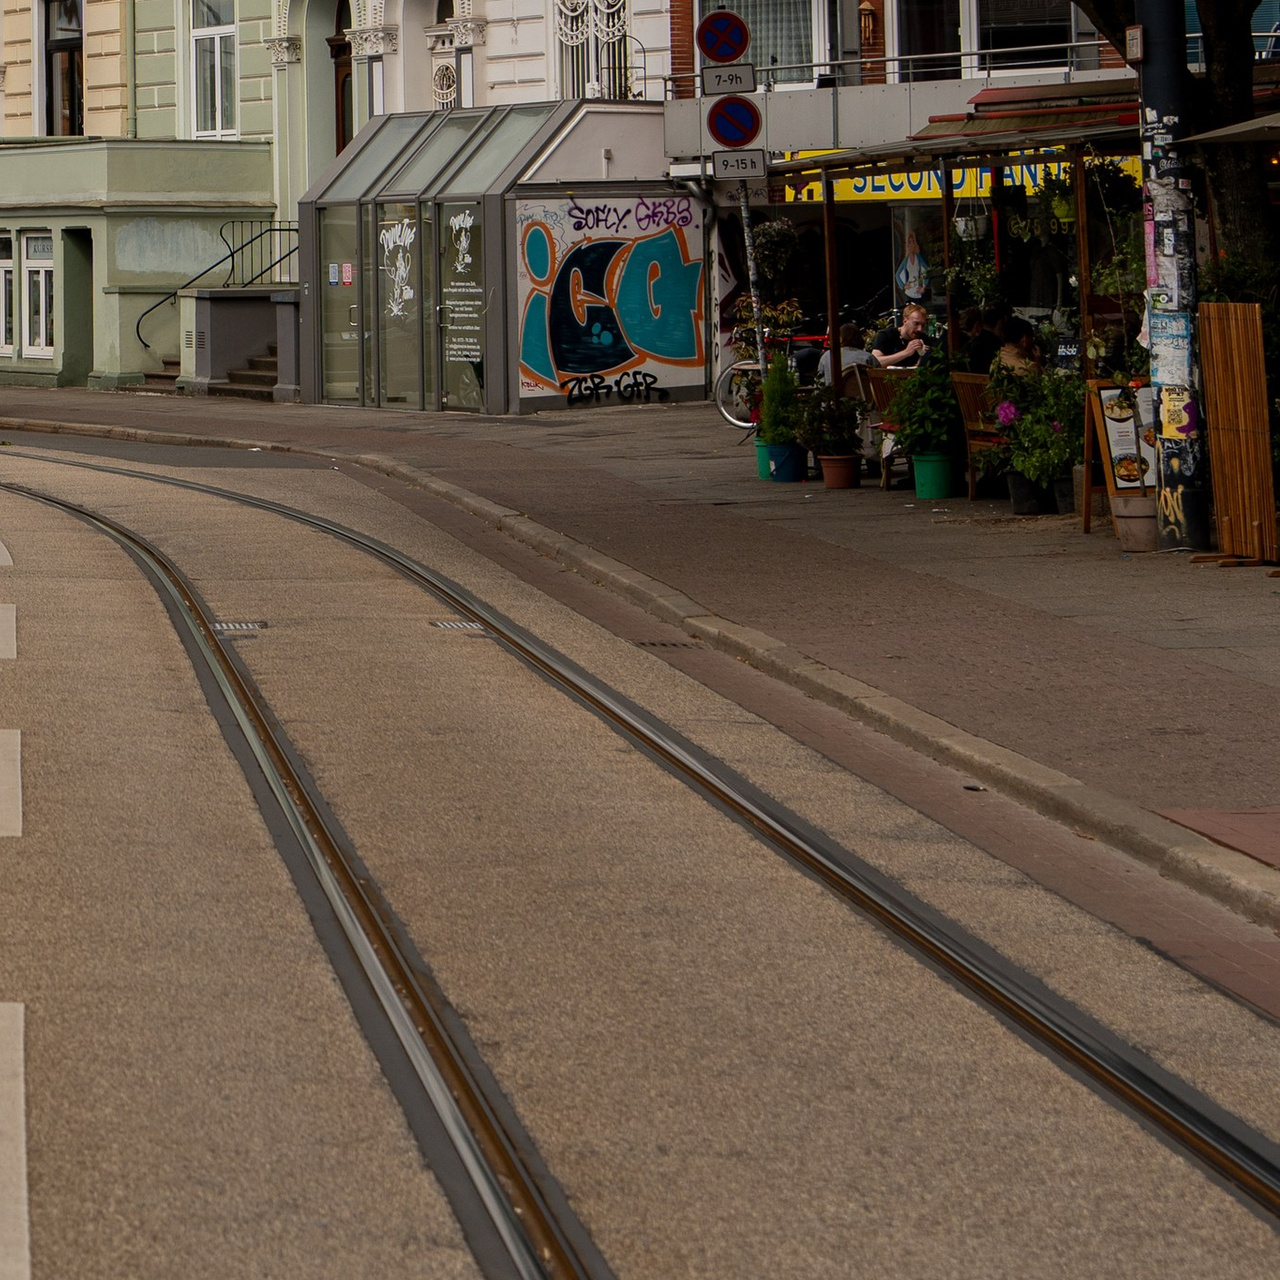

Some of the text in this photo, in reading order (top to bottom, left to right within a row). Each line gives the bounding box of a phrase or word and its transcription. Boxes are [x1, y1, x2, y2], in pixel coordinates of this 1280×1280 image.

[715, 74, 742, 86] 7-9h
[722, 158, 757, 171] 9-15 h
